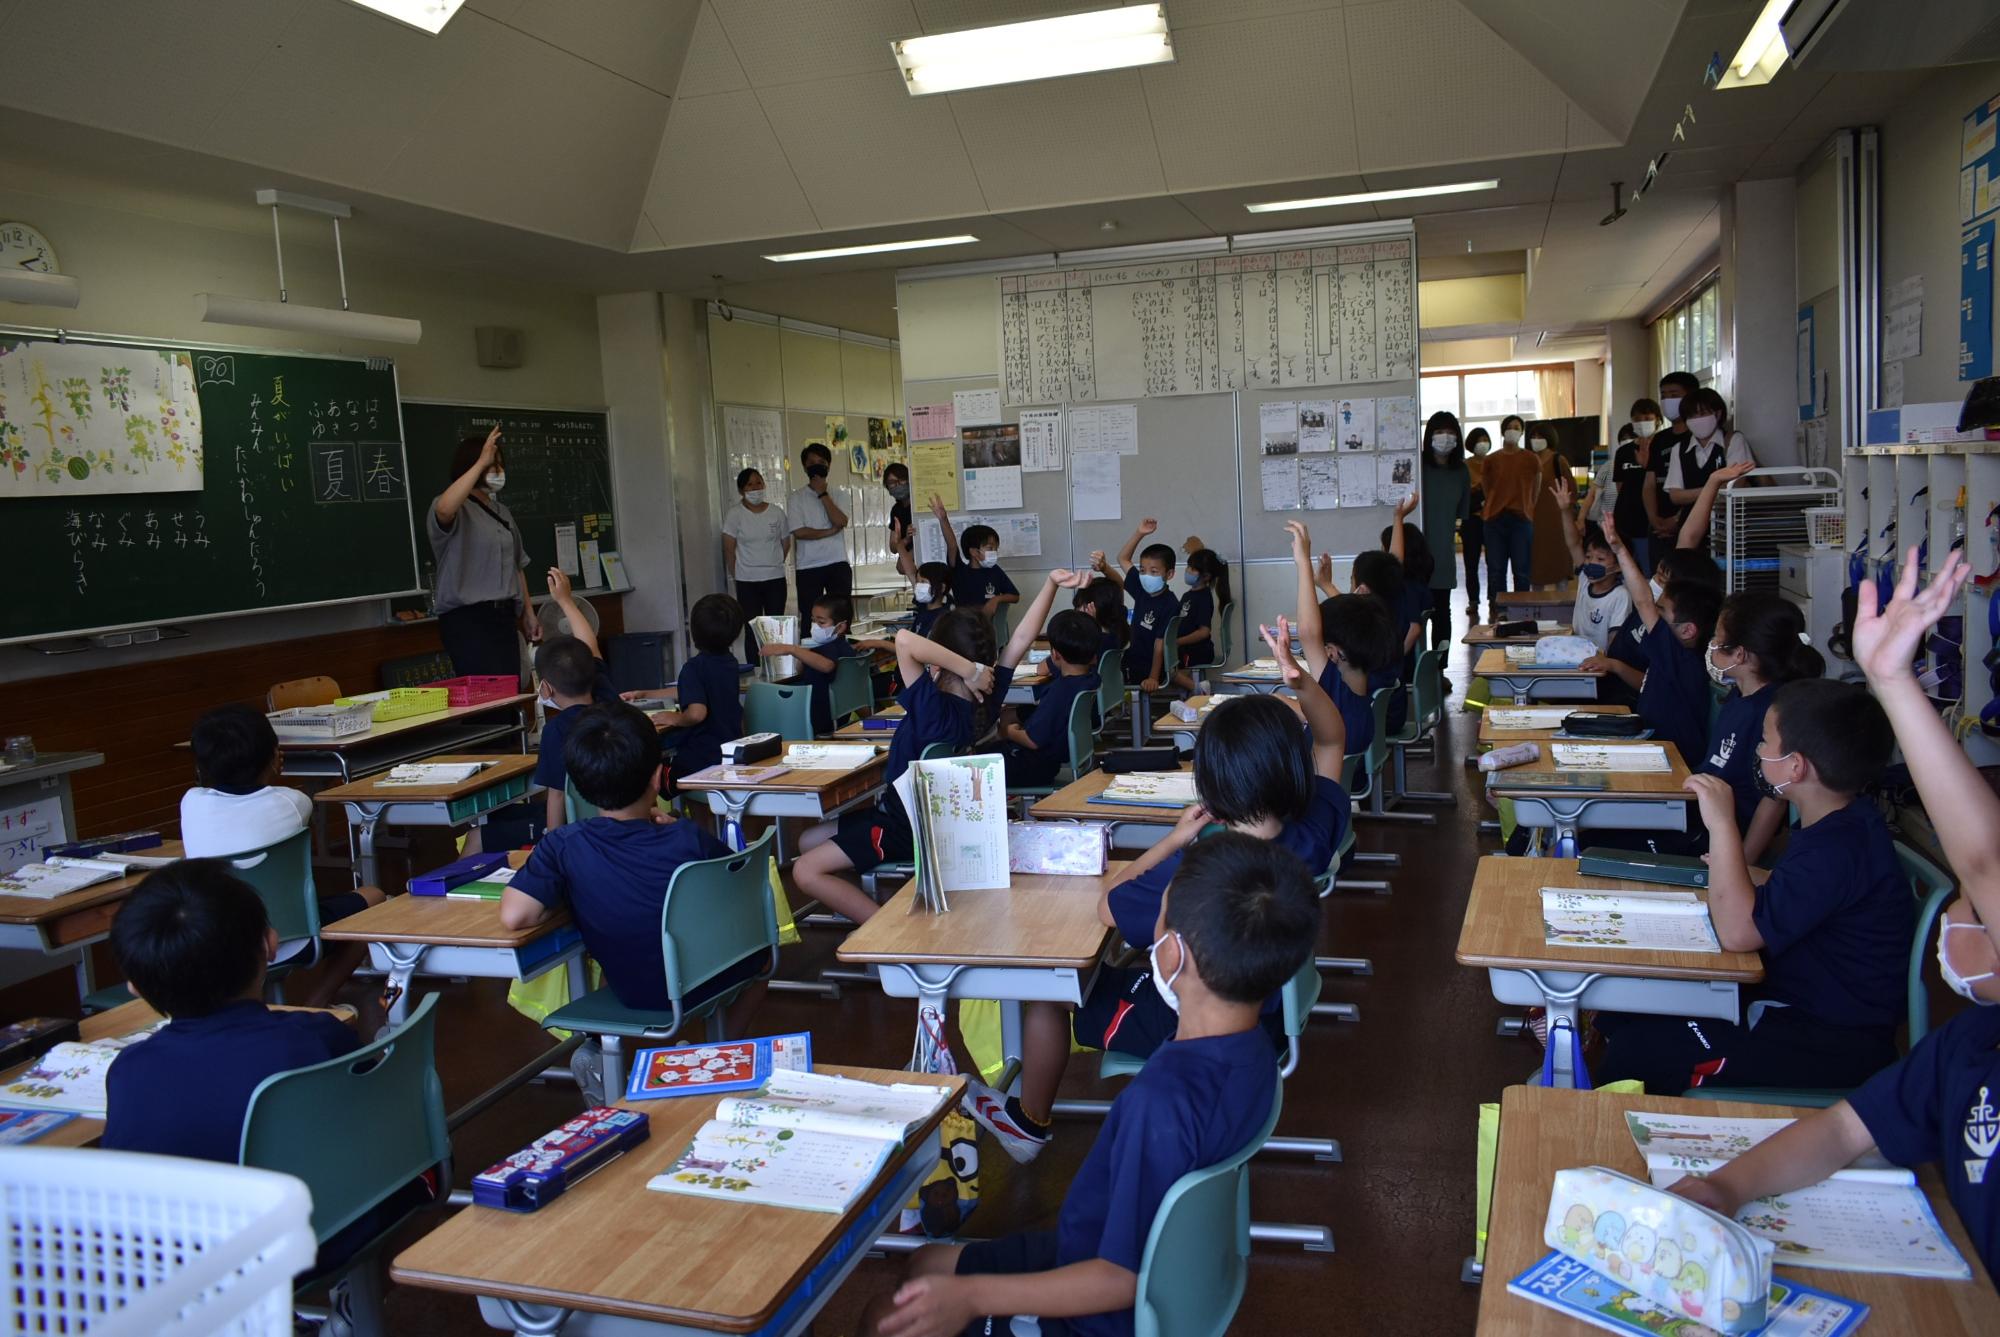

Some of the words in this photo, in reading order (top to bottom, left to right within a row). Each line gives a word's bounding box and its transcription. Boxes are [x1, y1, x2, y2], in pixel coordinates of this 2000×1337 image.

[204, 359, 227, 378] 90
[250, 393, 263, 454] みんみん
[270, 375, 294, 492] 夏がいっぱい
[308, 400, 326, 439] ふゆ
[327, 399, 341, 436] あき
[346, 399, 360, 433] なつ
[319, 449, 353, 500] 夏
[367, 447, 401, 494] 春
[88, 511, 108, 552] なみ
[118, 511, 136, 548] ぐみ
[144, 508, 162, 550] あみ
[170, 511, 189, 549] せみ
[193, 509, 211, 549] うみ
[64, 508, 88, 595] 海びらき
